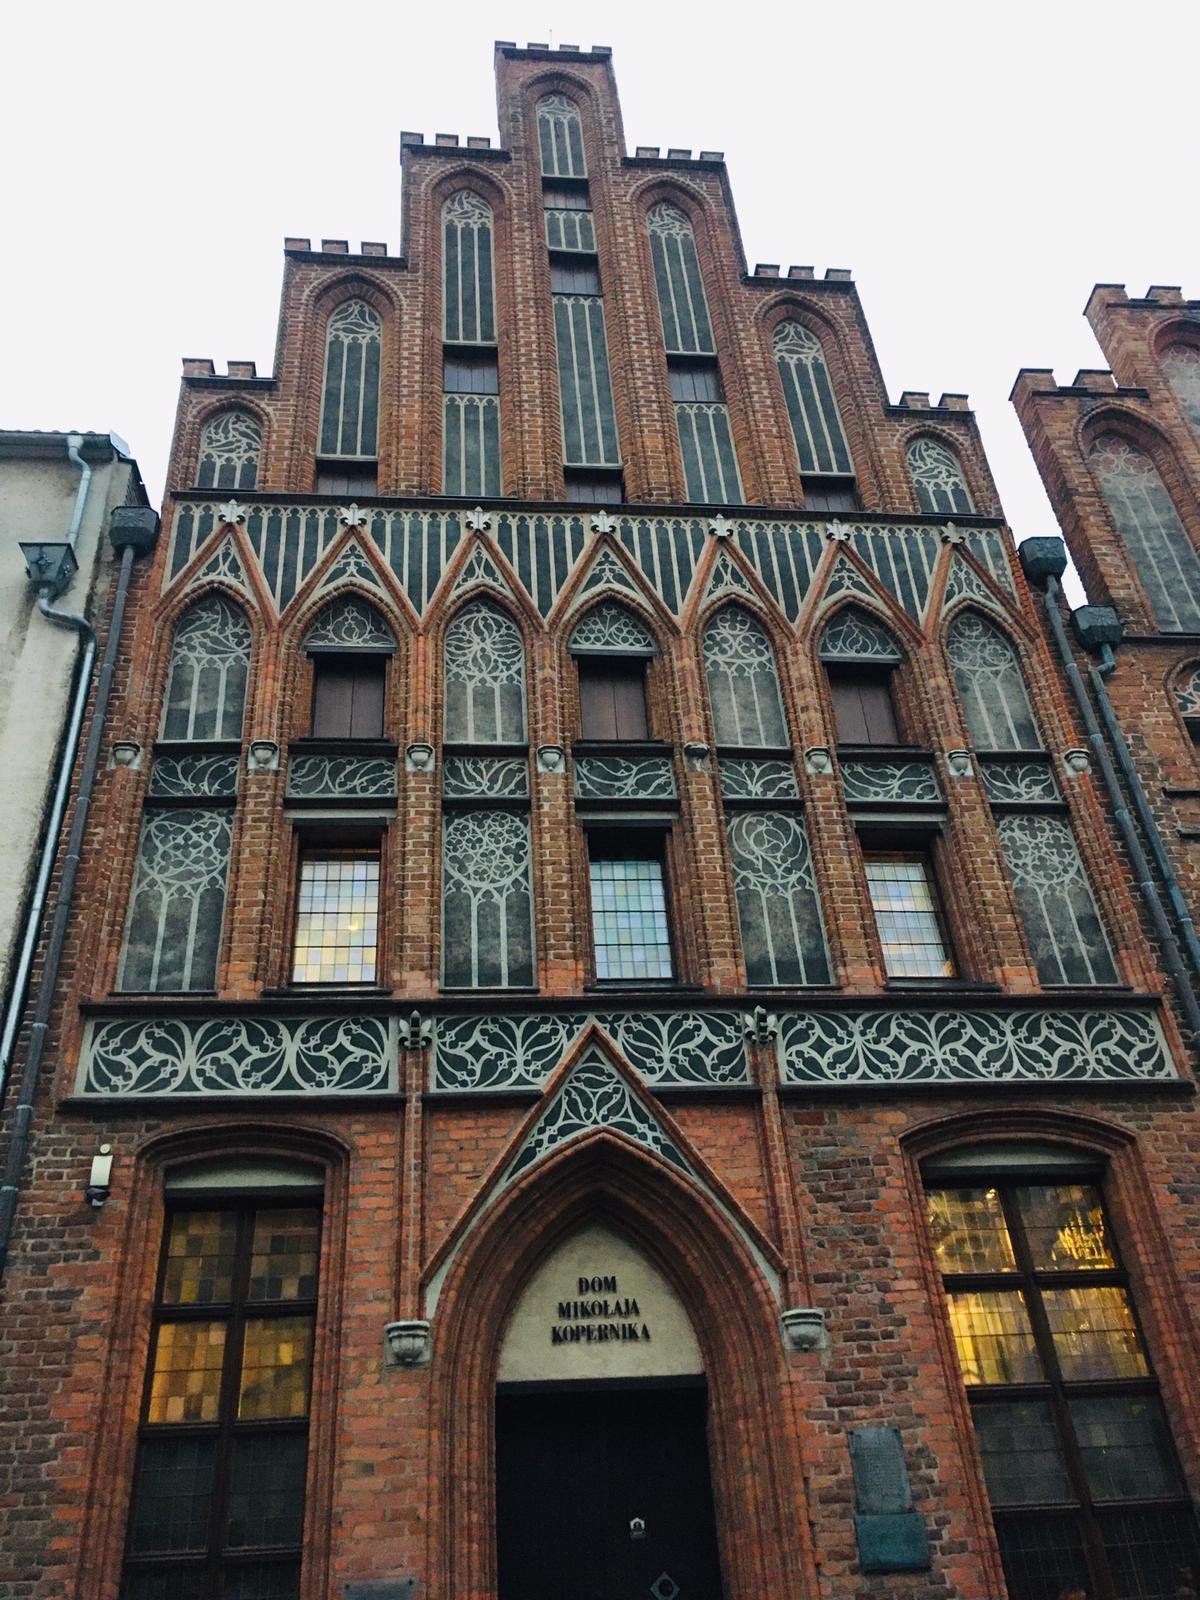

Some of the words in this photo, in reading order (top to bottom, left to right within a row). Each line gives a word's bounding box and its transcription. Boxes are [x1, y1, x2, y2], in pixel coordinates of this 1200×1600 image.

[578, 1276, 617, 1295] DOM
[558, 1298, 640, 1320] MIKOŁAJA
[551, 1323, 651, 1345] KOPERNIKA
